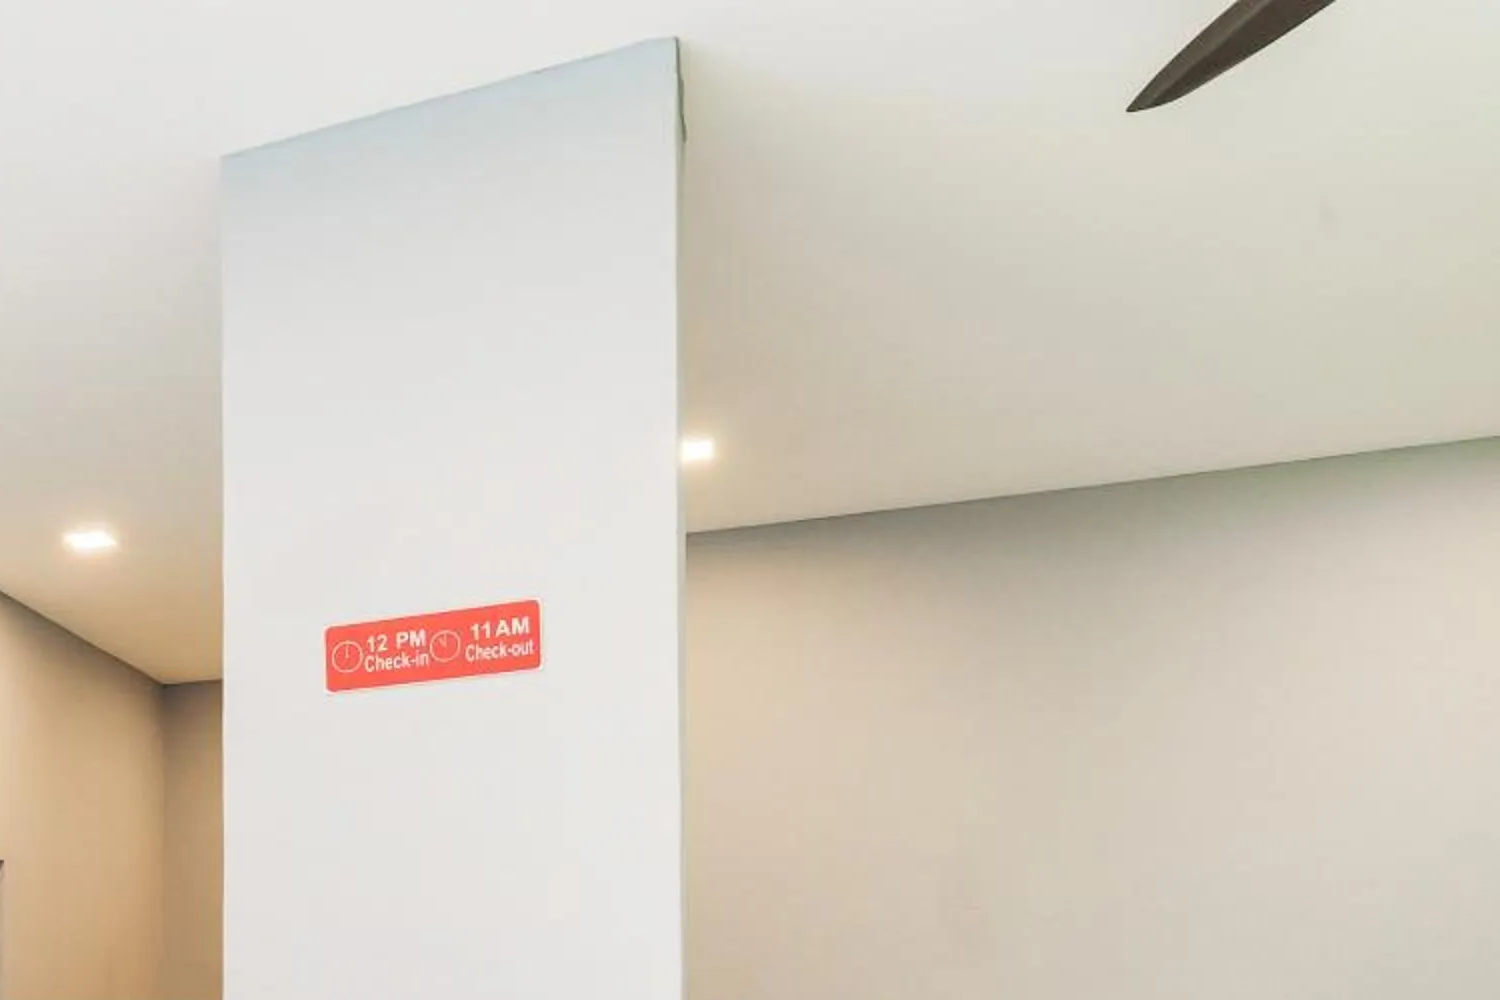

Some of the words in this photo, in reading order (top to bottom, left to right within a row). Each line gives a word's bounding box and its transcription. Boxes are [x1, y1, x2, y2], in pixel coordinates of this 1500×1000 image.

[367, 634, 388, 653] 12
[396, 629, 427, 649] PM
[465, 639, 534, 662] Check-out
[364, 650, 429, 672] Check-in
